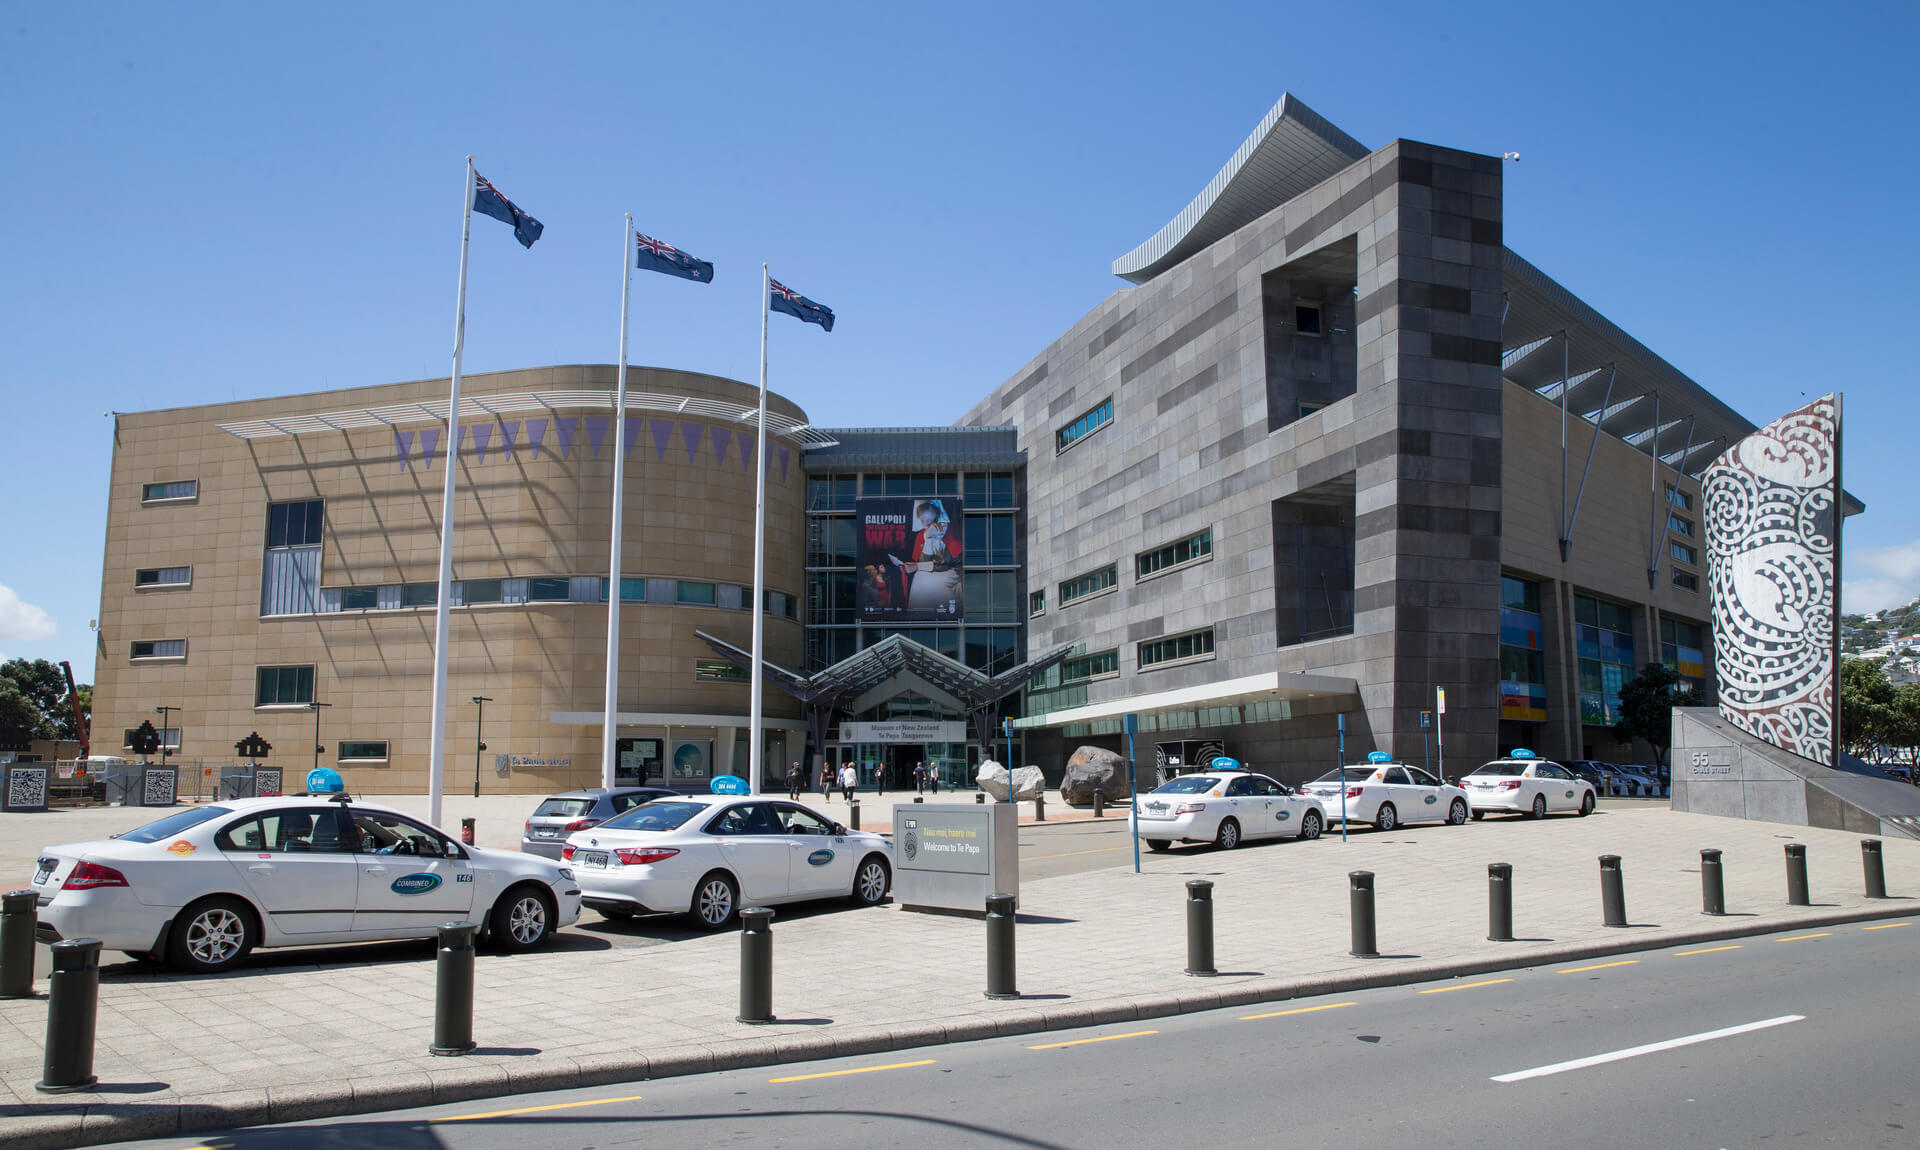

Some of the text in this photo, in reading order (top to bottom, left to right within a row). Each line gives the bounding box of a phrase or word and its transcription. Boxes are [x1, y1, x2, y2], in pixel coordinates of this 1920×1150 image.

[865, 514, 906, 524] GALLIPOLI
[865, 530, 906, 549] WAR
[885, 732, 900, 740] Papa
[901, 732, 934, 740] Tongarewa
[1692, 751, 1709, 768] 55
[1711, 767, 1731, 775] STREET
[923, 826, 935, 837] Nau
[948, 828, 965, 839] haere
[966, 829, 977, 839] mai
[923, 841, 980, 856] Welcome to Te Papa
[457, 874, 472, 882] 146
[396, 879, 430, 888] COMBINED
